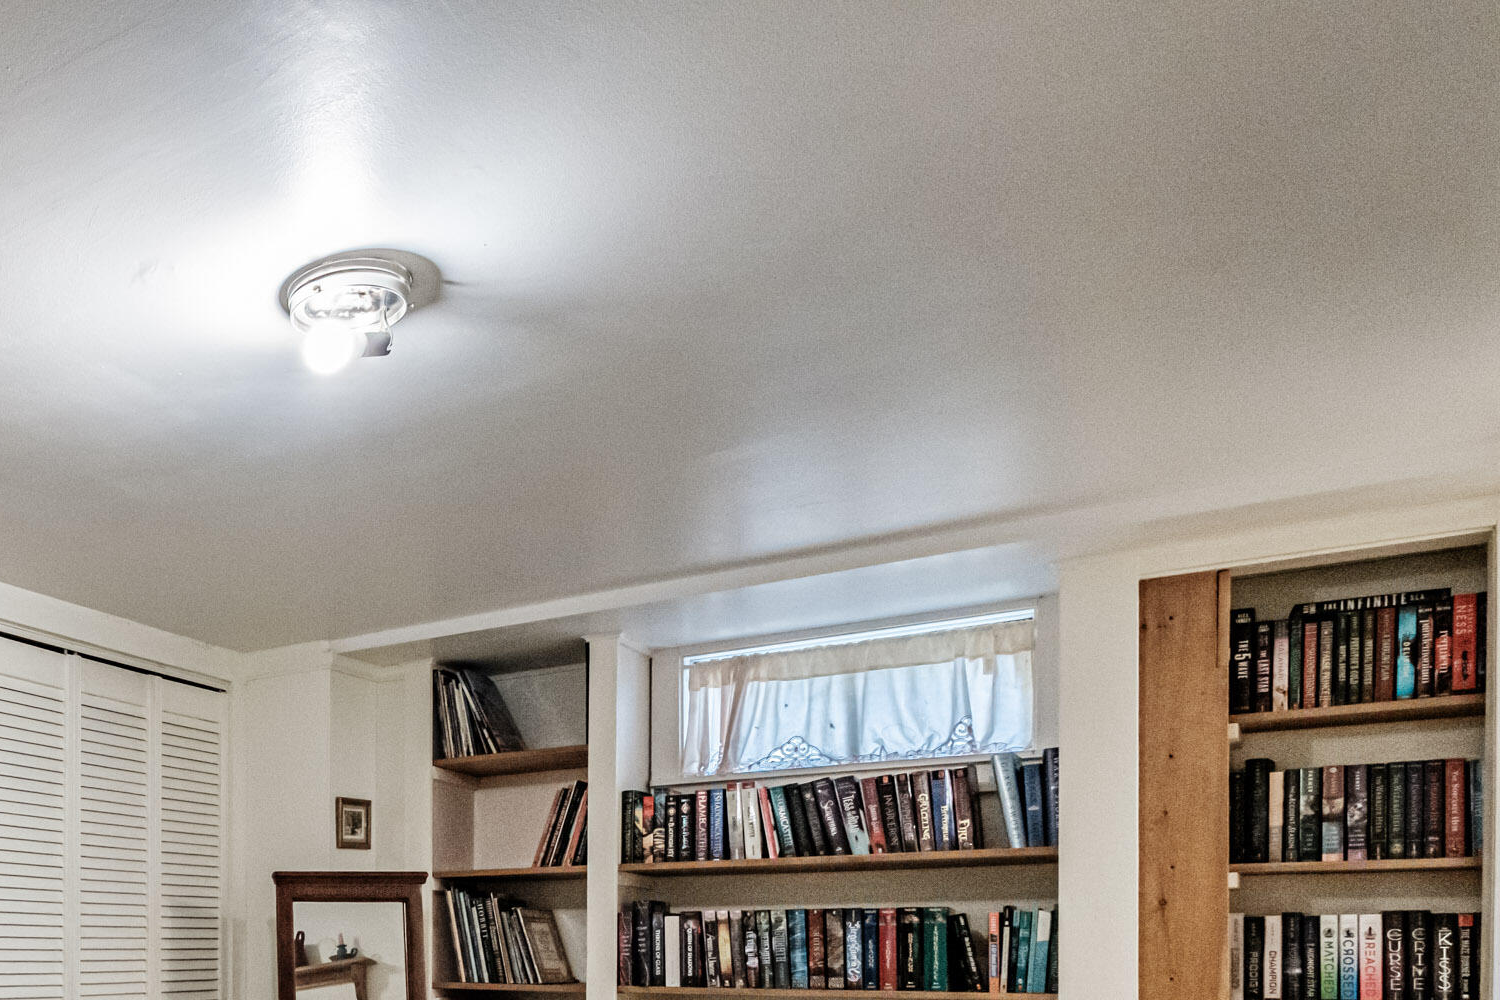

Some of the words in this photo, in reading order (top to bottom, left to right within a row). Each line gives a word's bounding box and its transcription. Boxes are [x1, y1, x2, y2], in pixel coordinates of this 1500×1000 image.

[1339, 593, 1408, 612] INFINITE
[1455, 605, 1468, 636] NESS
[1233, 653, 1252, 662] 5
[1238, 640, 1249, 653] THE
[1257, 659, 1270, 676] LAST
[1418, 619, 1433, 685] pandemonium
[1436, 630, 1451, 674] requiem
[1237, 661, 1249, 680] WAVE
[1256, 677, 1270, 694] STAR
[776, 794, 794, 848] STORMCASTER
[842, 795, 856, 813] TESS
[917, 793, 931, 841] GRACELING
[957, 819, 971, 843] FIRE
[476, 903, 489, 939] HOBBIT
[1249, 951, 1259, 995] PRODIGY
[1268, 950, 1278, 995] CHAMPION
[1323, 941, 1335, 995] MATCHED
[1341, 939, 1355, 999] CROSSED
[1364, 942, 1376, 999] REACHED
[1387, 927, 1403, 992] CURSE
[1411, 926, 1428, 991] CRIME
